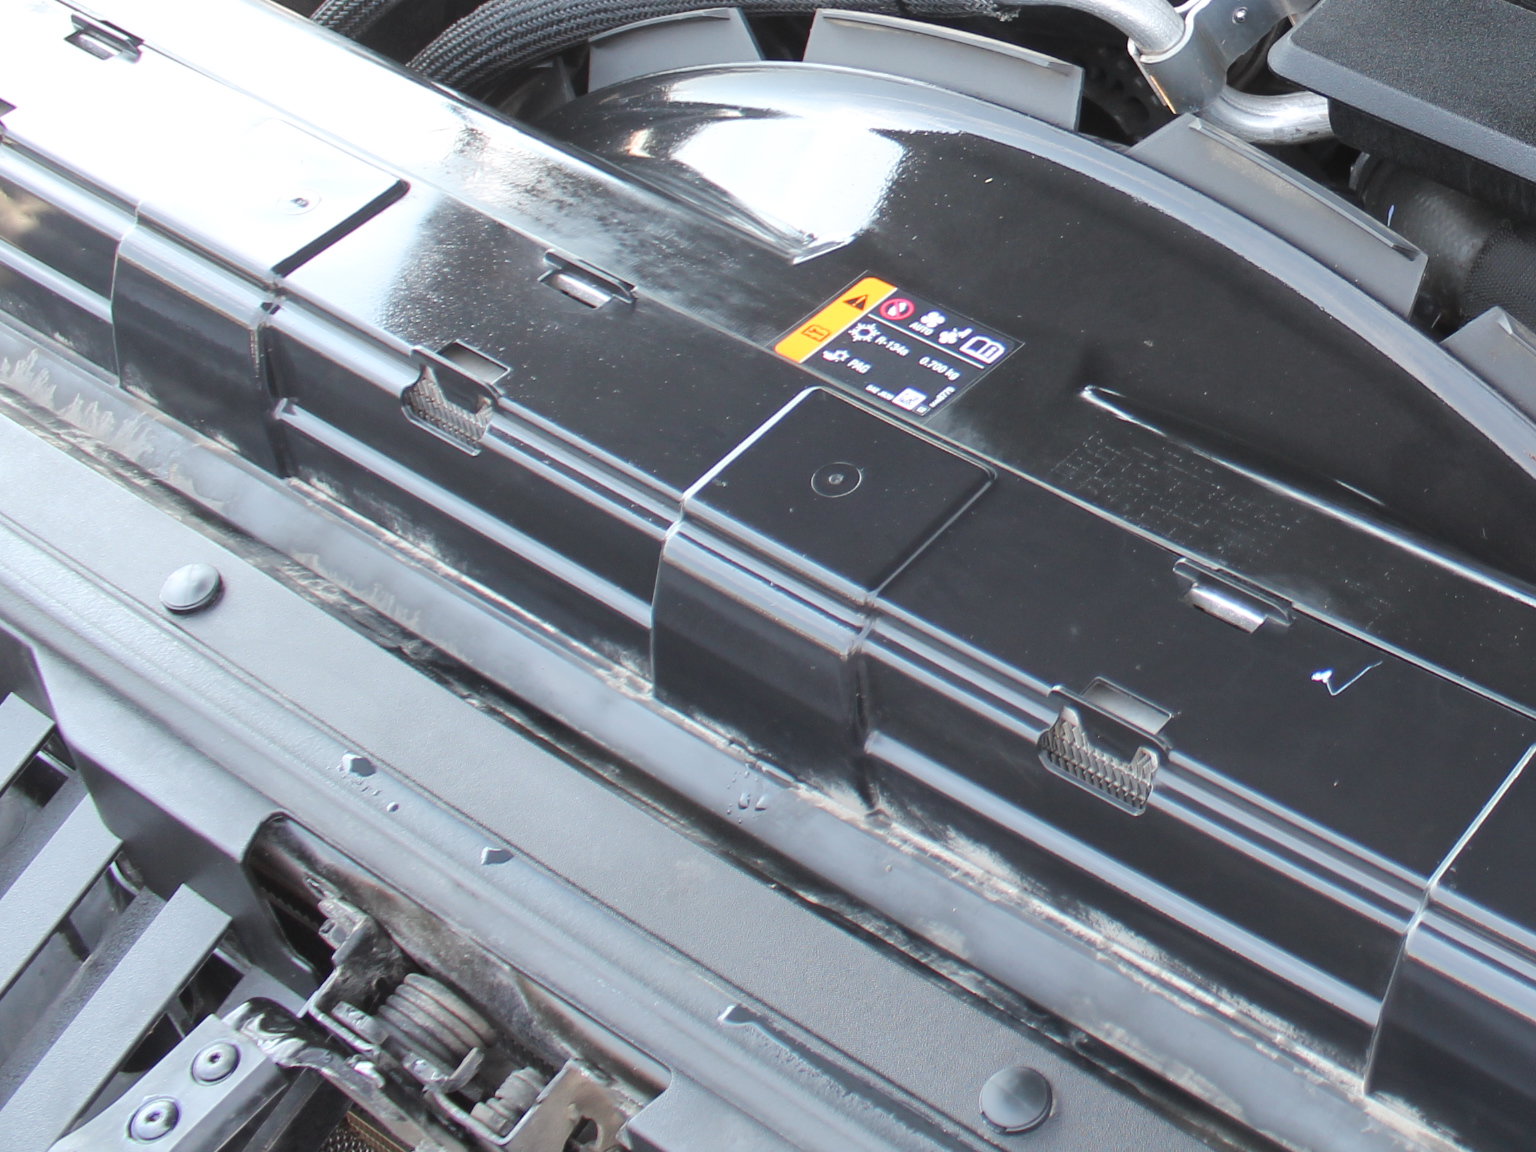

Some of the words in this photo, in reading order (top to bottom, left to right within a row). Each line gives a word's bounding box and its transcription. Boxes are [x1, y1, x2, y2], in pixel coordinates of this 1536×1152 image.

[908, 321, 934, 336] AUTO
[846, 358, 872, 375] PAG
[944, 368, 960, 381] kg
